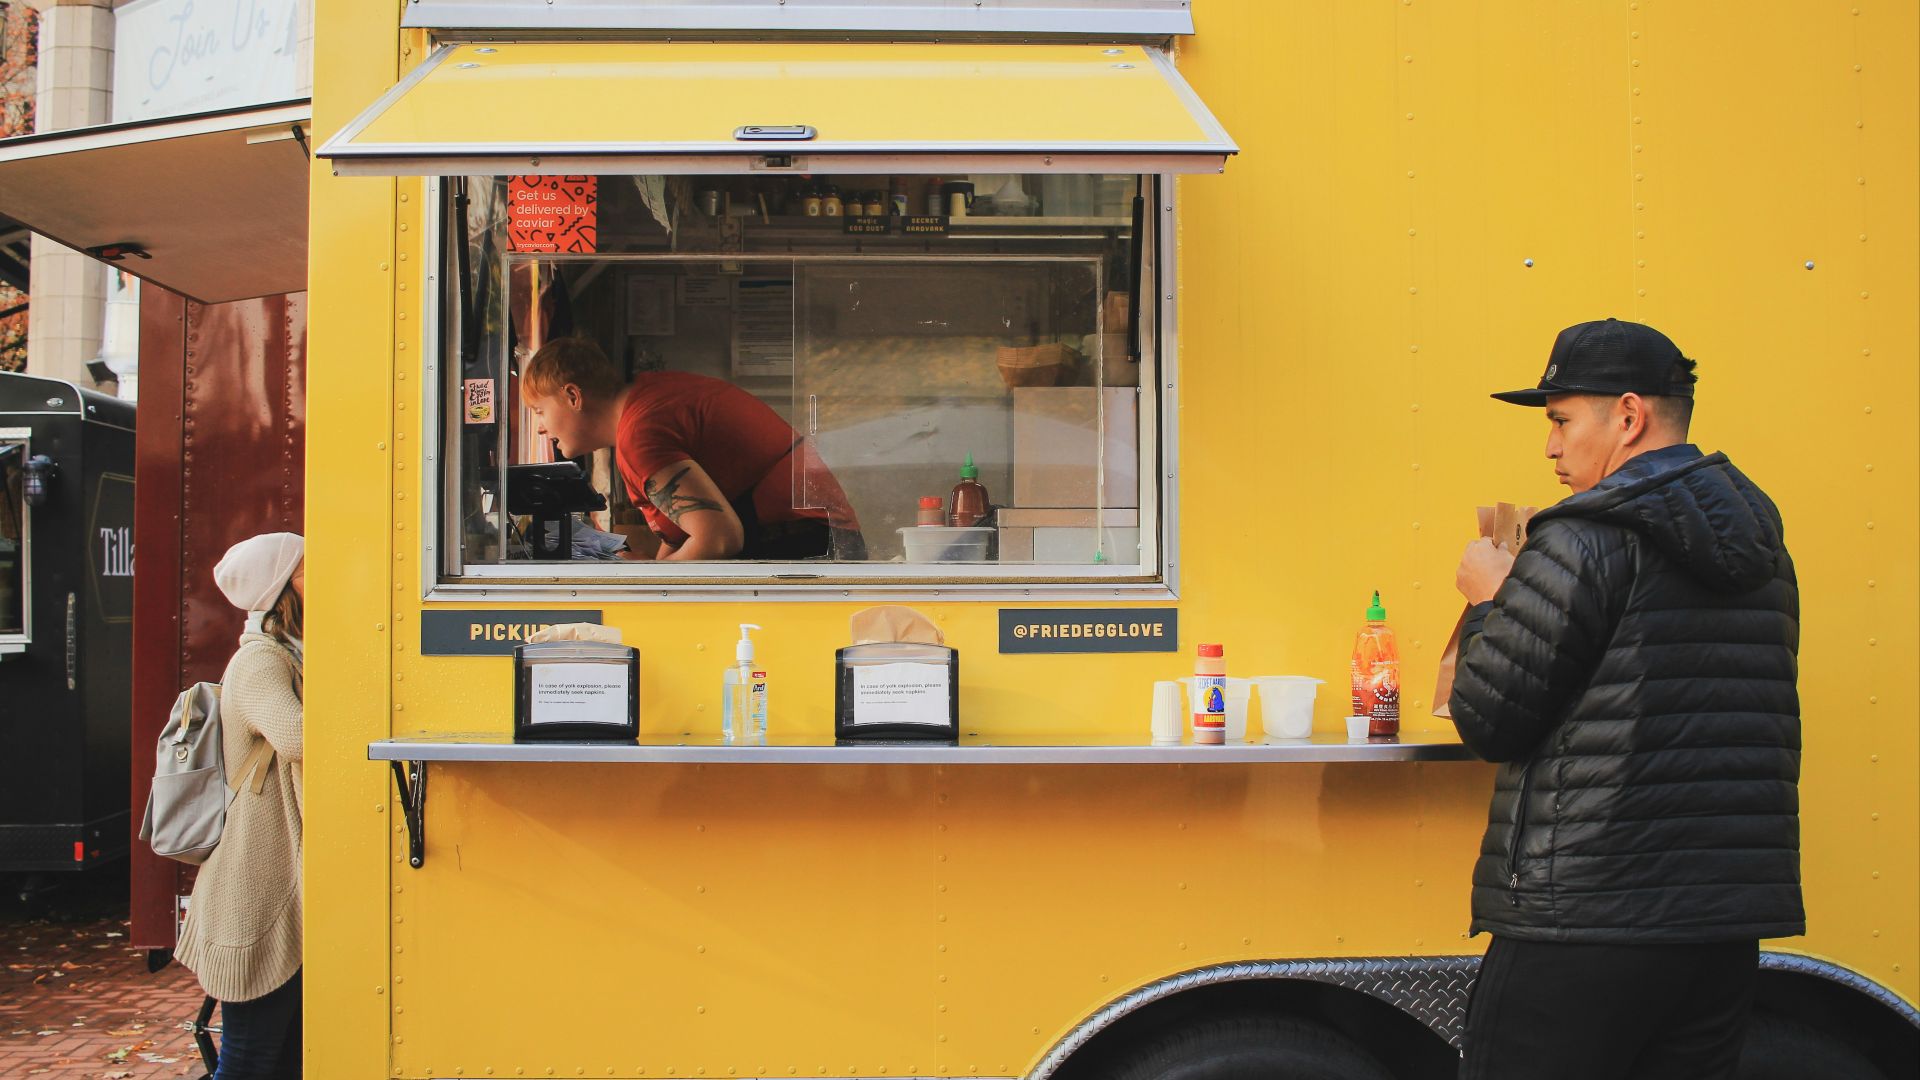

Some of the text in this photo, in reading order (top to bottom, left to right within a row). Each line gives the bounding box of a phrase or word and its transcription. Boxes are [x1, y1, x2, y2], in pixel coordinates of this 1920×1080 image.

[149, 0, 219, 90] Join
[516, 190, 557, 201] Get us
[516, 204, 589, 217] delivered by
[516, 218, 555, 228] caviar
[1013, 623, 1164, 639] @FRIEDEGGLOVE
